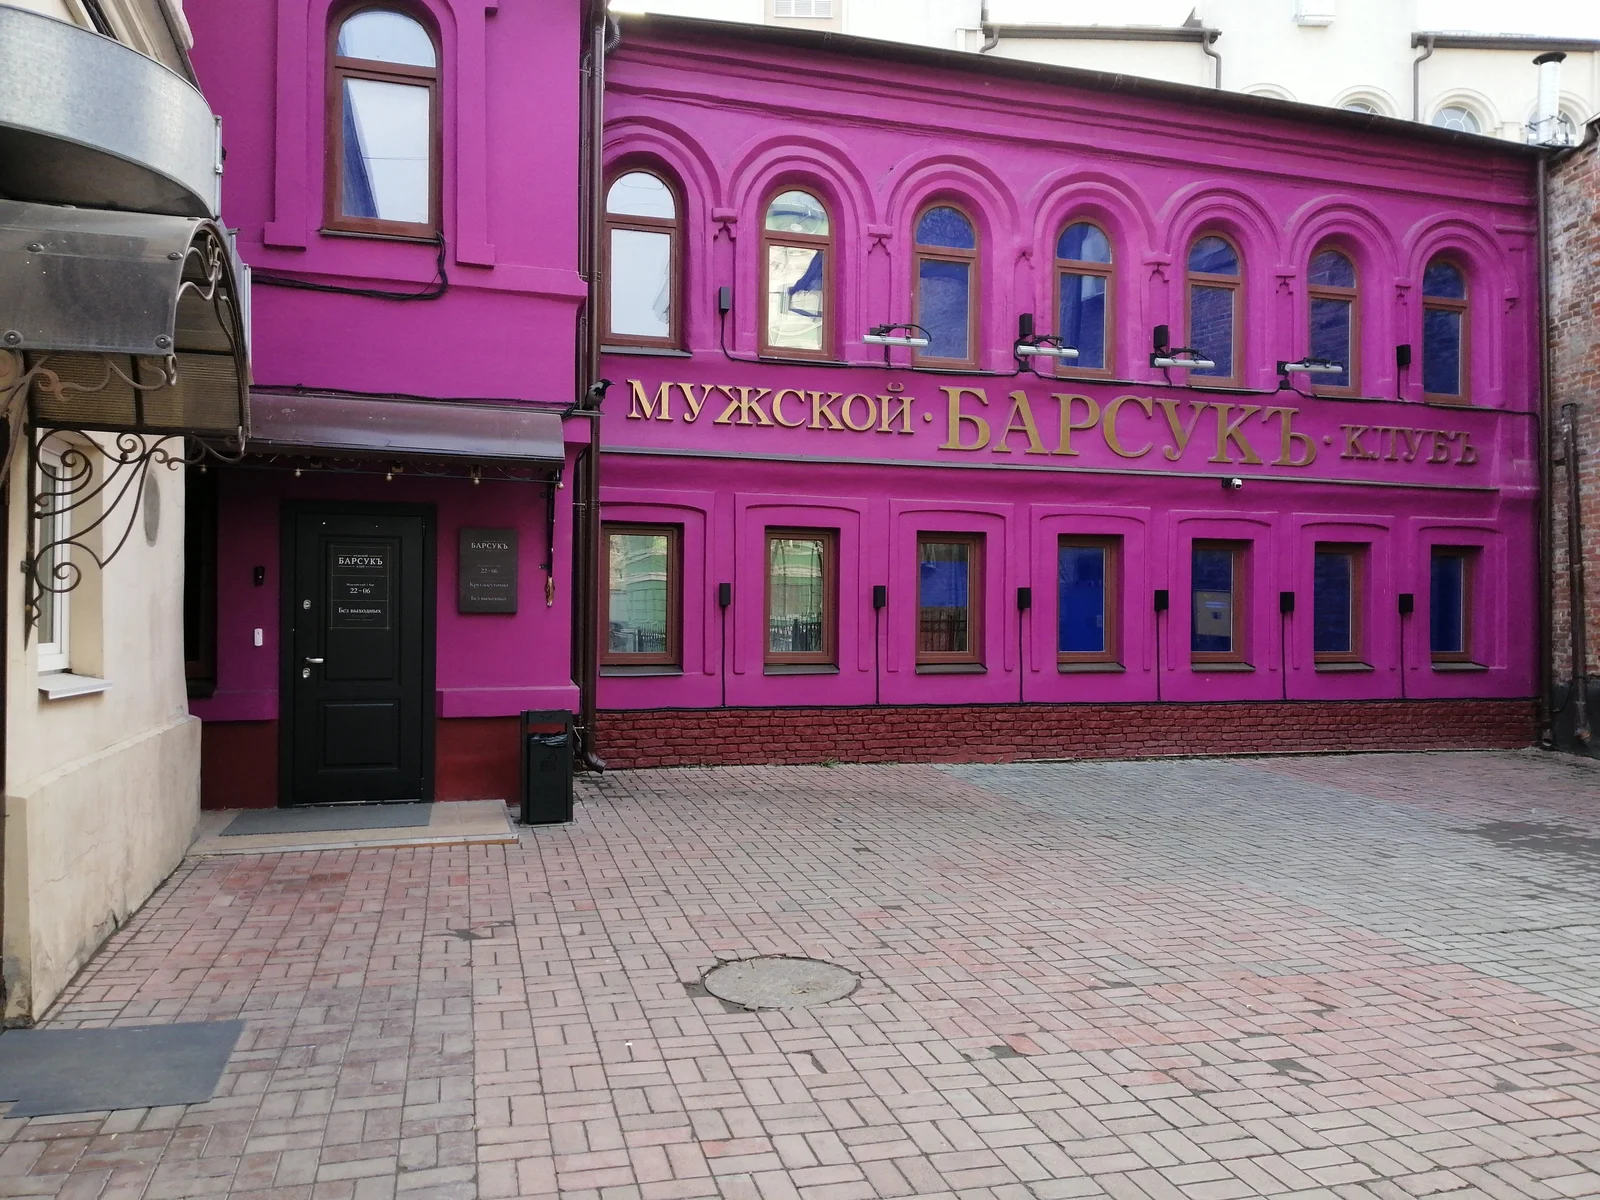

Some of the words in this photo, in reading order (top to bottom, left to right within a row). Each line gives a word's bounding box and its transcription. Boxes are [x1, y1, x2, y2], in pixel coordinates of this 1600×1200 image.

[627, 380, 914, 434] МУЖСКОЙ
[938, 386, 1317, 467] БАРСУКЪ
[1340, 424, 1480, 465] КЛУБЪ
[471, 542, 509, 550] БАРСУКЪ
[338, 557, 383, 565] БАРСУКЪ
